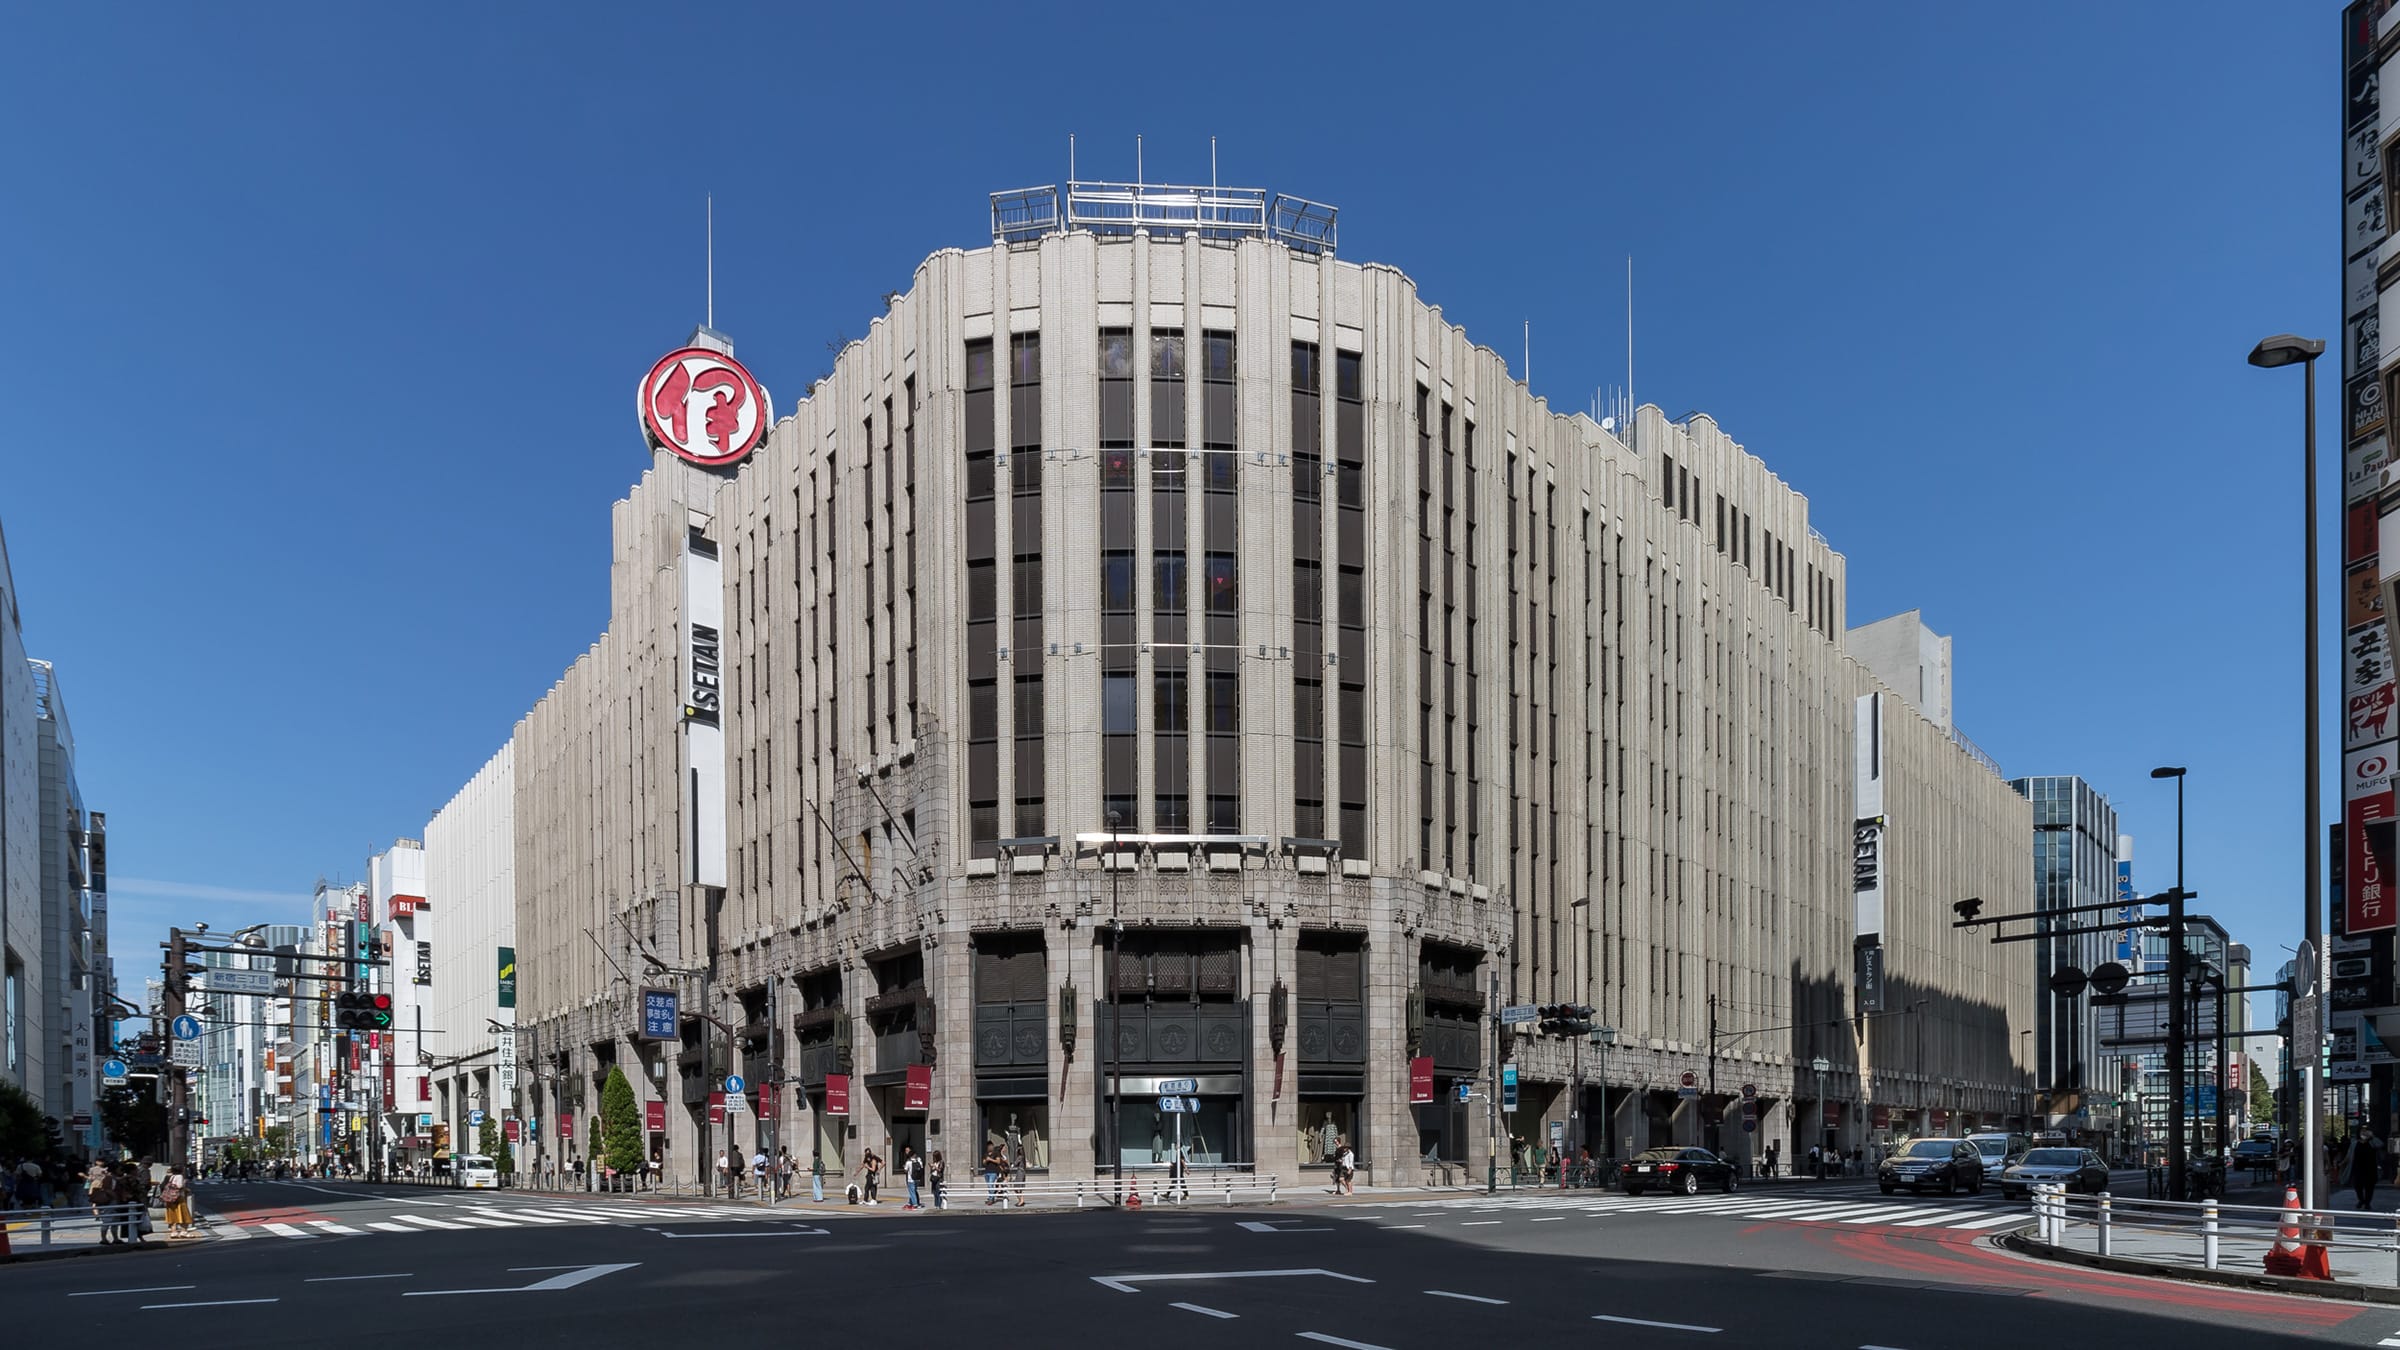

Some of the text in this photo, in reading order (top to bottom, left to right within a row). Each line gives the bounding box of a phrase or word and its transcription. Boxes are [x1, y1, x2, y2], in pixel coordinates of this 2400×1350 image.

[2350, 471, 2361, 482] La
[2356, 777, 2388, 791] MUFG
[2362, 803, 2381, 919] 三UFJ銀行
[214, 972, 269, 984] 新宿三丁目
[647, 996, 674, 1008] 交差点
[647, 1009, 673, 1020] 事故多し
[648, 1021, 673, 1032] 注意
[74, 1022, 90, 1078] 大和証券
[502, 1031, 514, 1091] 井住友銀行
